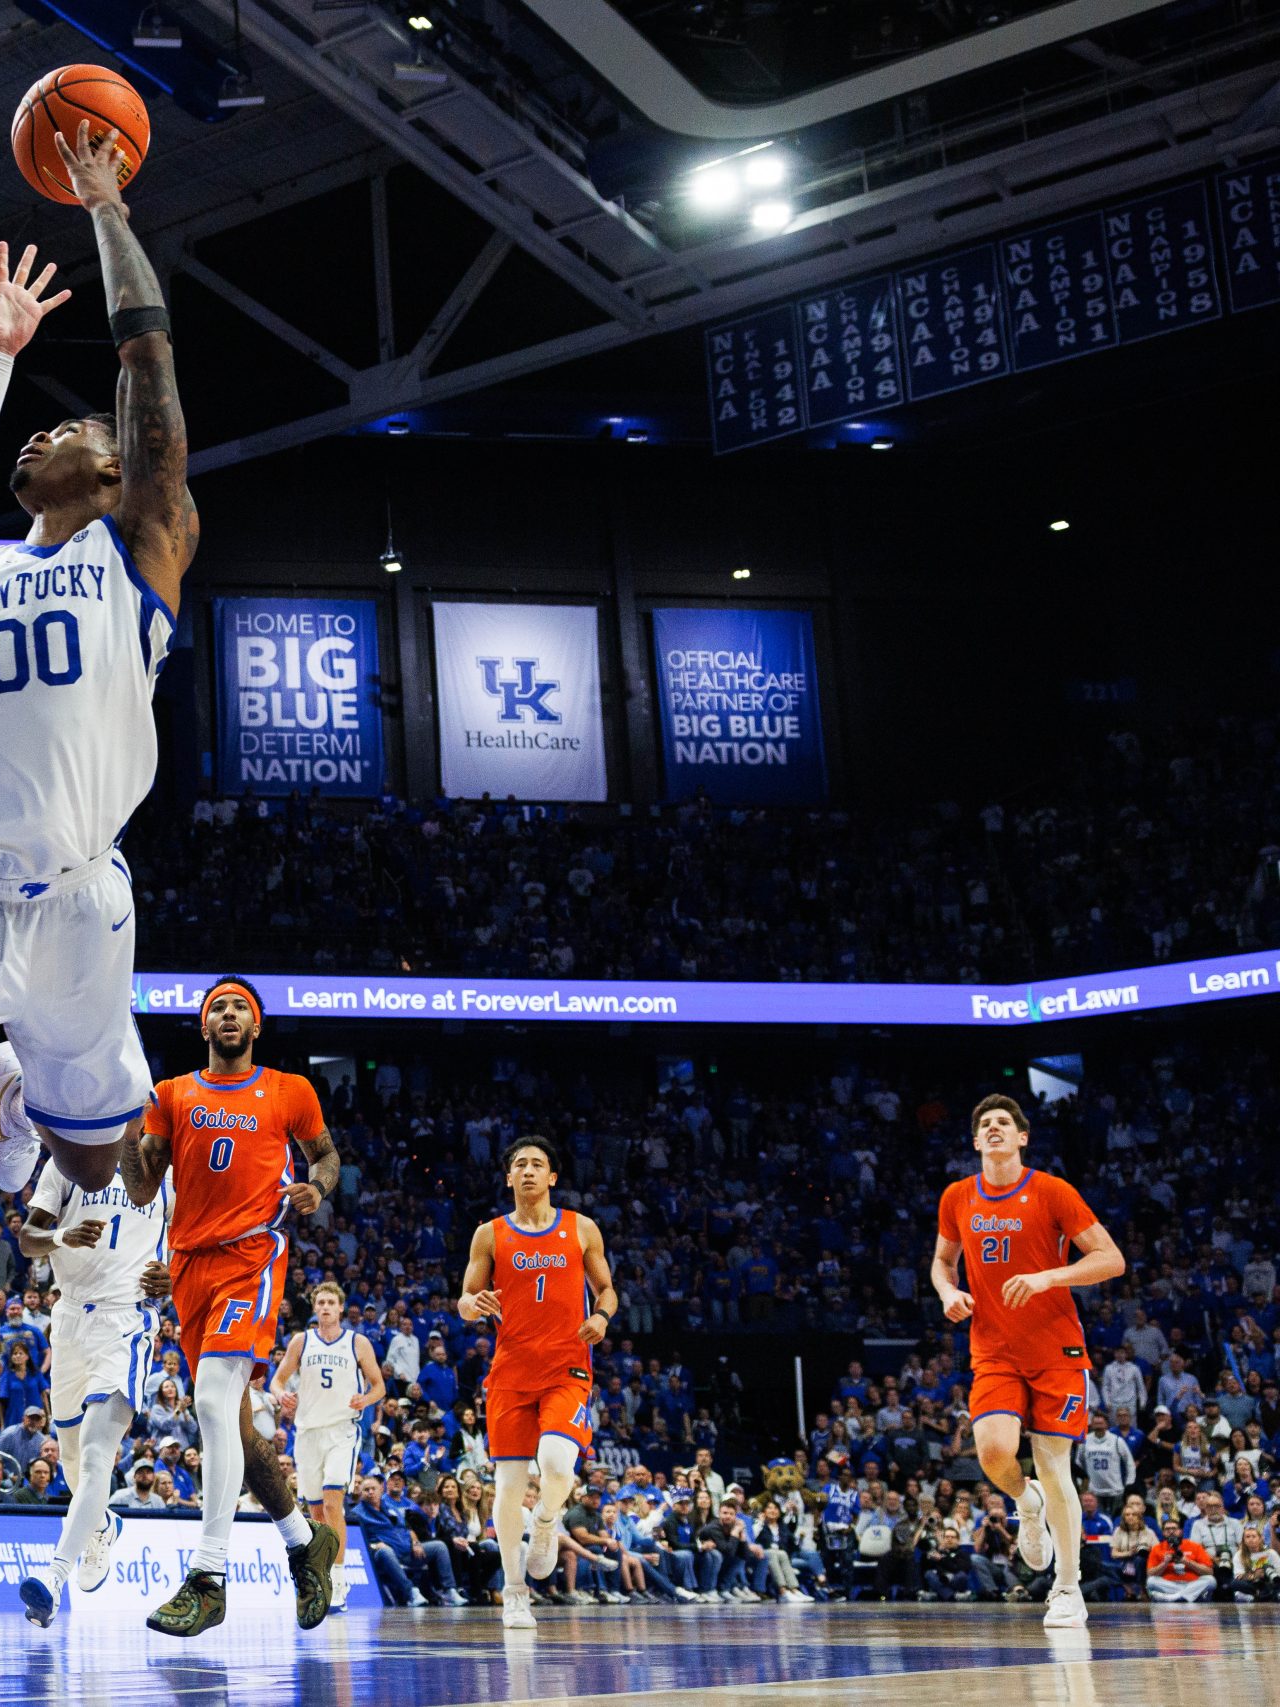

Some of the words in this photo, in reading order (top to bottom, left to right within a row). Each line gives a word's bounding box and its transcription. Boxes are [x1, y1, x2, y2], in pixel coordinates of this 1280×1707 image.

[1225, 174, 1262, 276] NCAA
[1106, 211, 1142, 310] NCAA
[1145, 206, 1179, 321] CHAMPION
[1181, 219, 1214, 315] 1958
[1007, 238, 1042, 335] NCAA
[1045, 235, 1077, 347] CHAMPION
[1080, 249, 1109, 343] 1951
[904, 272, 937, 367] NCAA
[940, 266, 971, 376] CHAMPION
[972, 282, 1001, 373] 1949
[805, 299, 834, 393] NCAA
[712, 331, 739, 422] NCAA
[773, 338, 798, 427] 1942
[235, 613, 314, 635] HOME
[320, 614, 356, 636] TO
[236, 636, 358, 691] BIG
[667, 650, 762, 671] OFFICIAL
[476, 656, 563, 725] UK
[669, 672, 806, 692] HEALTHCARE
[239, 692, 360, 730] BLUE
[670, 693, 764, 712] PARTNER
[767, 693, 800, 712] OF
[240, 732, 361, 756] DETERMI
[464, 730, 581, 752] HealthCare
[673, 715, 721, 738] BIG
[729, 715, 801, 739] BLUE
[675, 741, 787, 765] NATION
[1188, 966, 1270, 995] Learn
[287, 986, 358, 1009] Learn
[363, 987, 428, 1011] More
[433, 989, 458, 1011] at
[461, 988, 678, 1014] ForeverLawn.com
[189, 1104, 259, 1132] Gators
[209, 1136, 235, 1173] 0
[109, 1213, 122, 1250] 1
[970, 1213, 1023, 1233] Gators
[512, 1250, 567, 1271] Gators
[981, 1235, 1011, 1264] 21
[535, 1273, 546, 1303] 1
[217, 1298, 252, 1336] F
[306, 1353, 350, 1370] KENTUCKY
[320, 1367, 334, 1389] 5
[1056, 1393, 1084, 1422] F
[3, 1564, 21, 1585] UP
[115, 1545, 170, 1597] safe,
